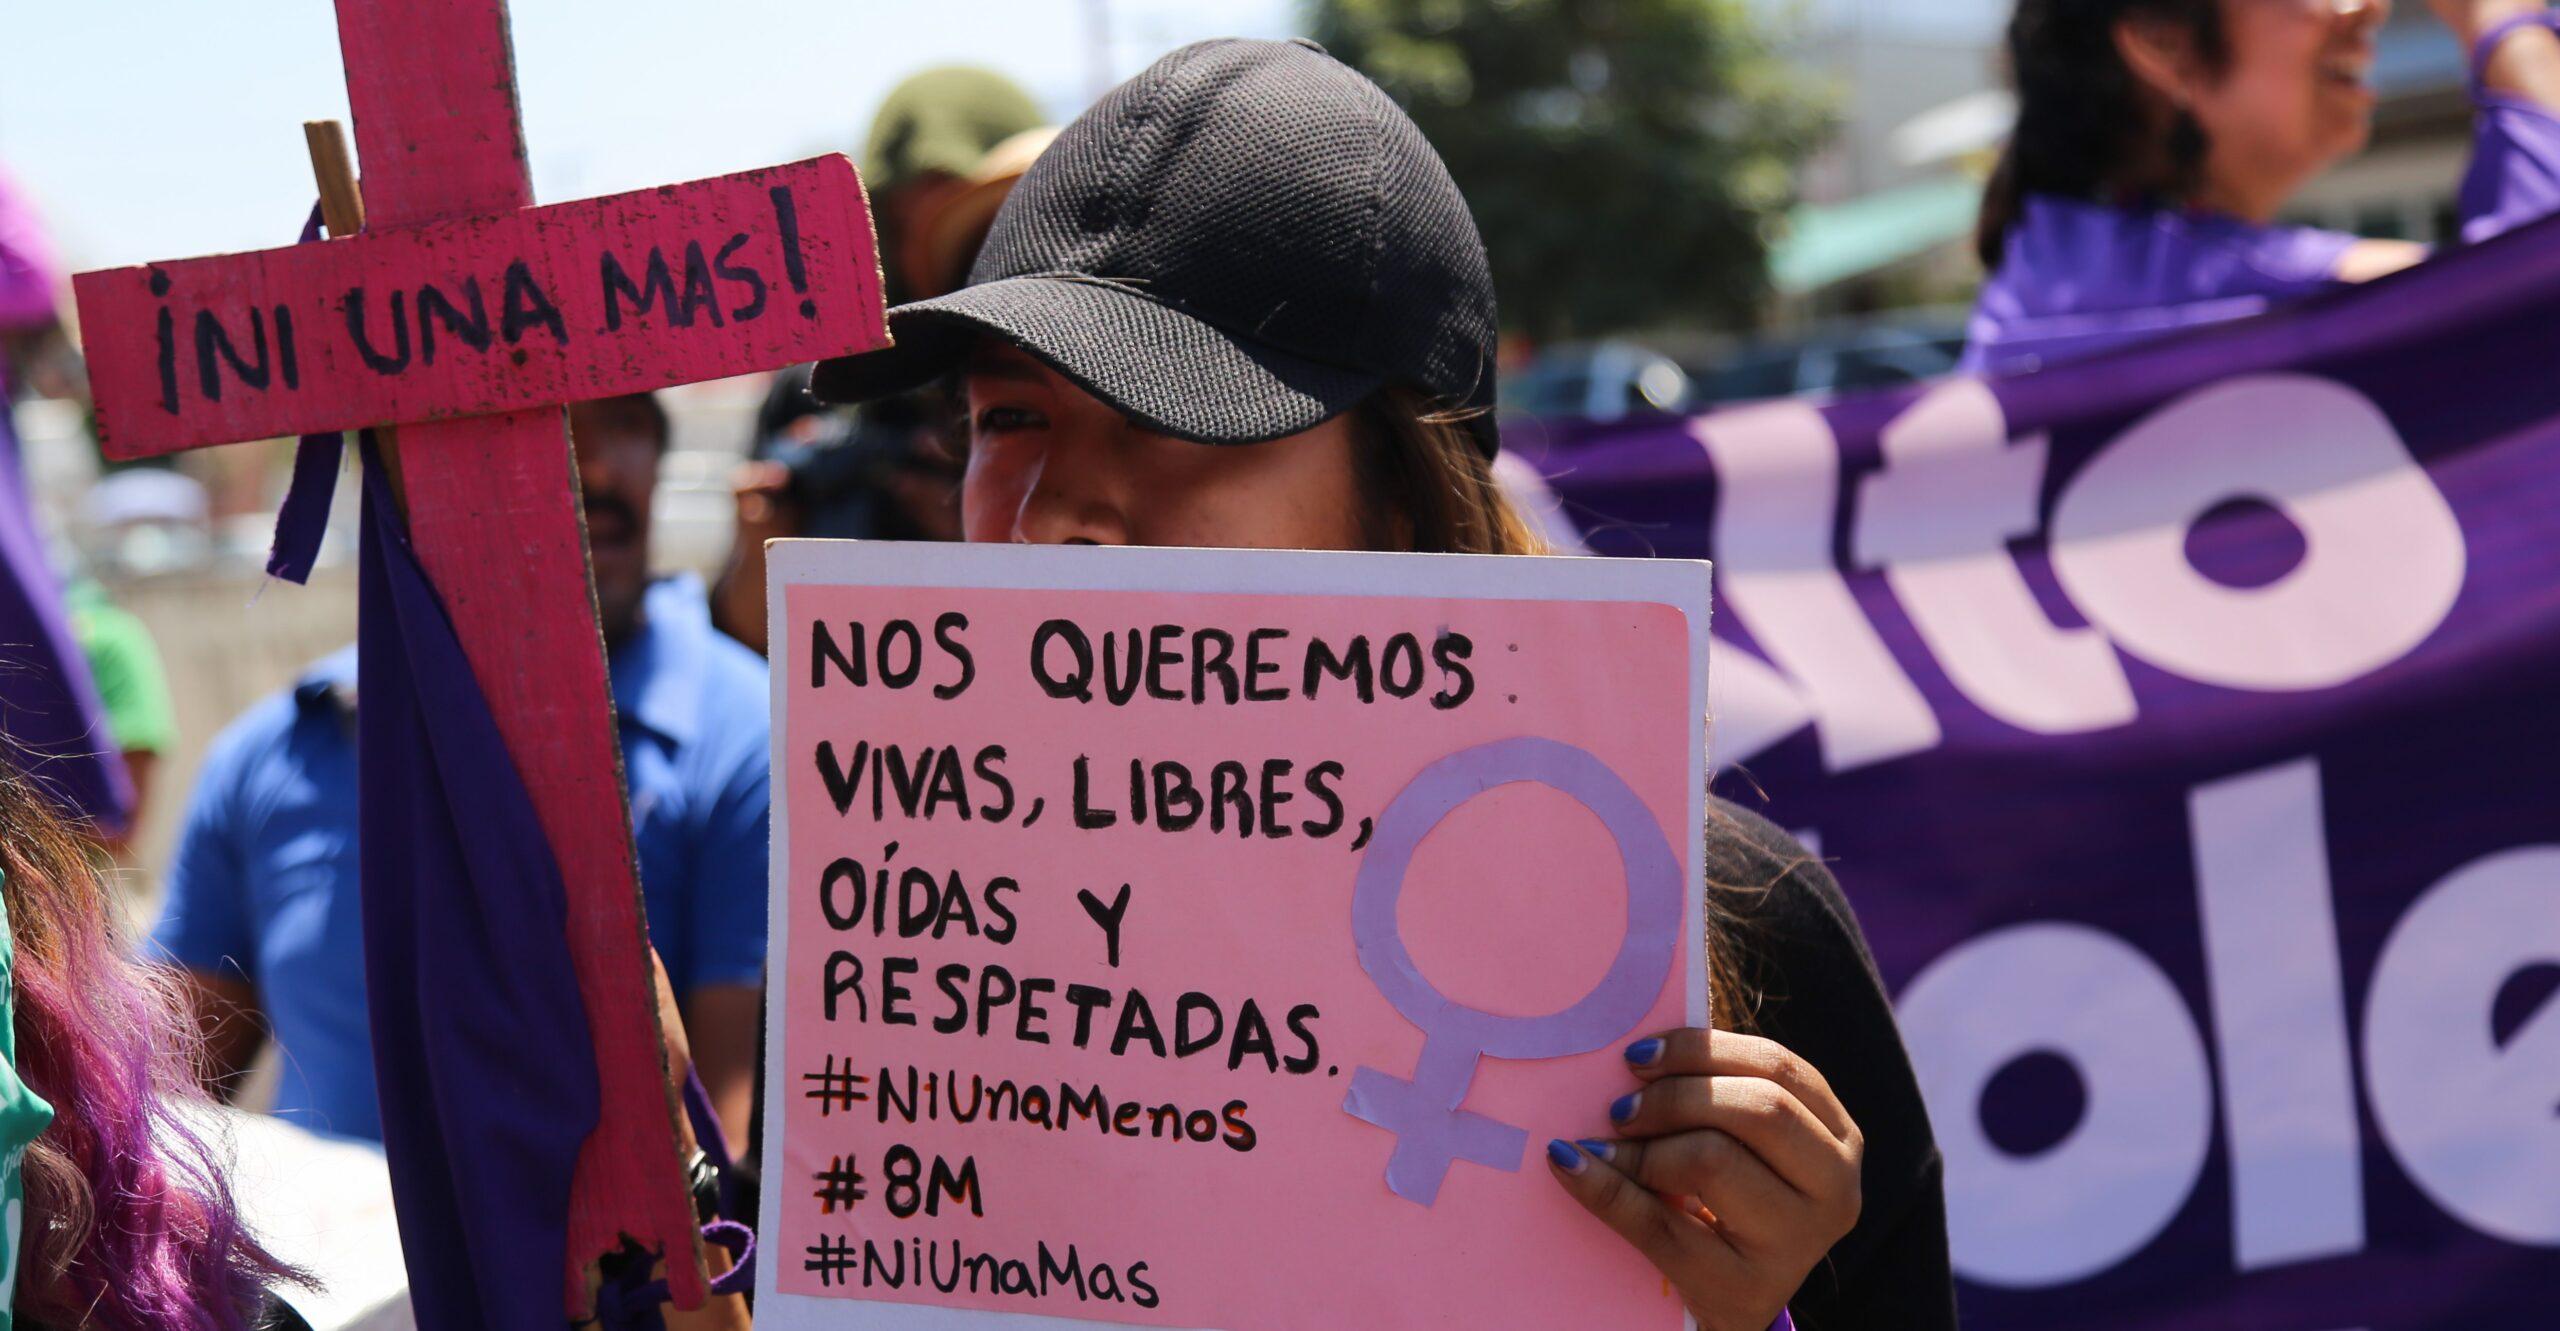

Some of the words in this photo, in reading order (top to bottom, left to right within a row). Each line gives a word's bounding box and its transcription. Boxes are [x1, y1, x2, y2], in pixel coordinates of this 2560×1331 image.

[148, 266, 300, 416] ¡NI
[344, 258, 569, 376] UNA
[599, 186, 817, 333] MAS!
[811, 612, 976, 700] NOS
[815, 740, 1045, 828] VIVAS,
[1072, 753, 1374, 852] LIBRES,
[819, 841, 1021, 945] OÍDAS
[1076, 883, 1131, 968] Y
[823, 950, 1339, 1077] RESPETADAS.
[803, 1053, 1257, 1153] #NiUnaMenos
[804, 1232, 1160, 1309] #NiUnaMas
